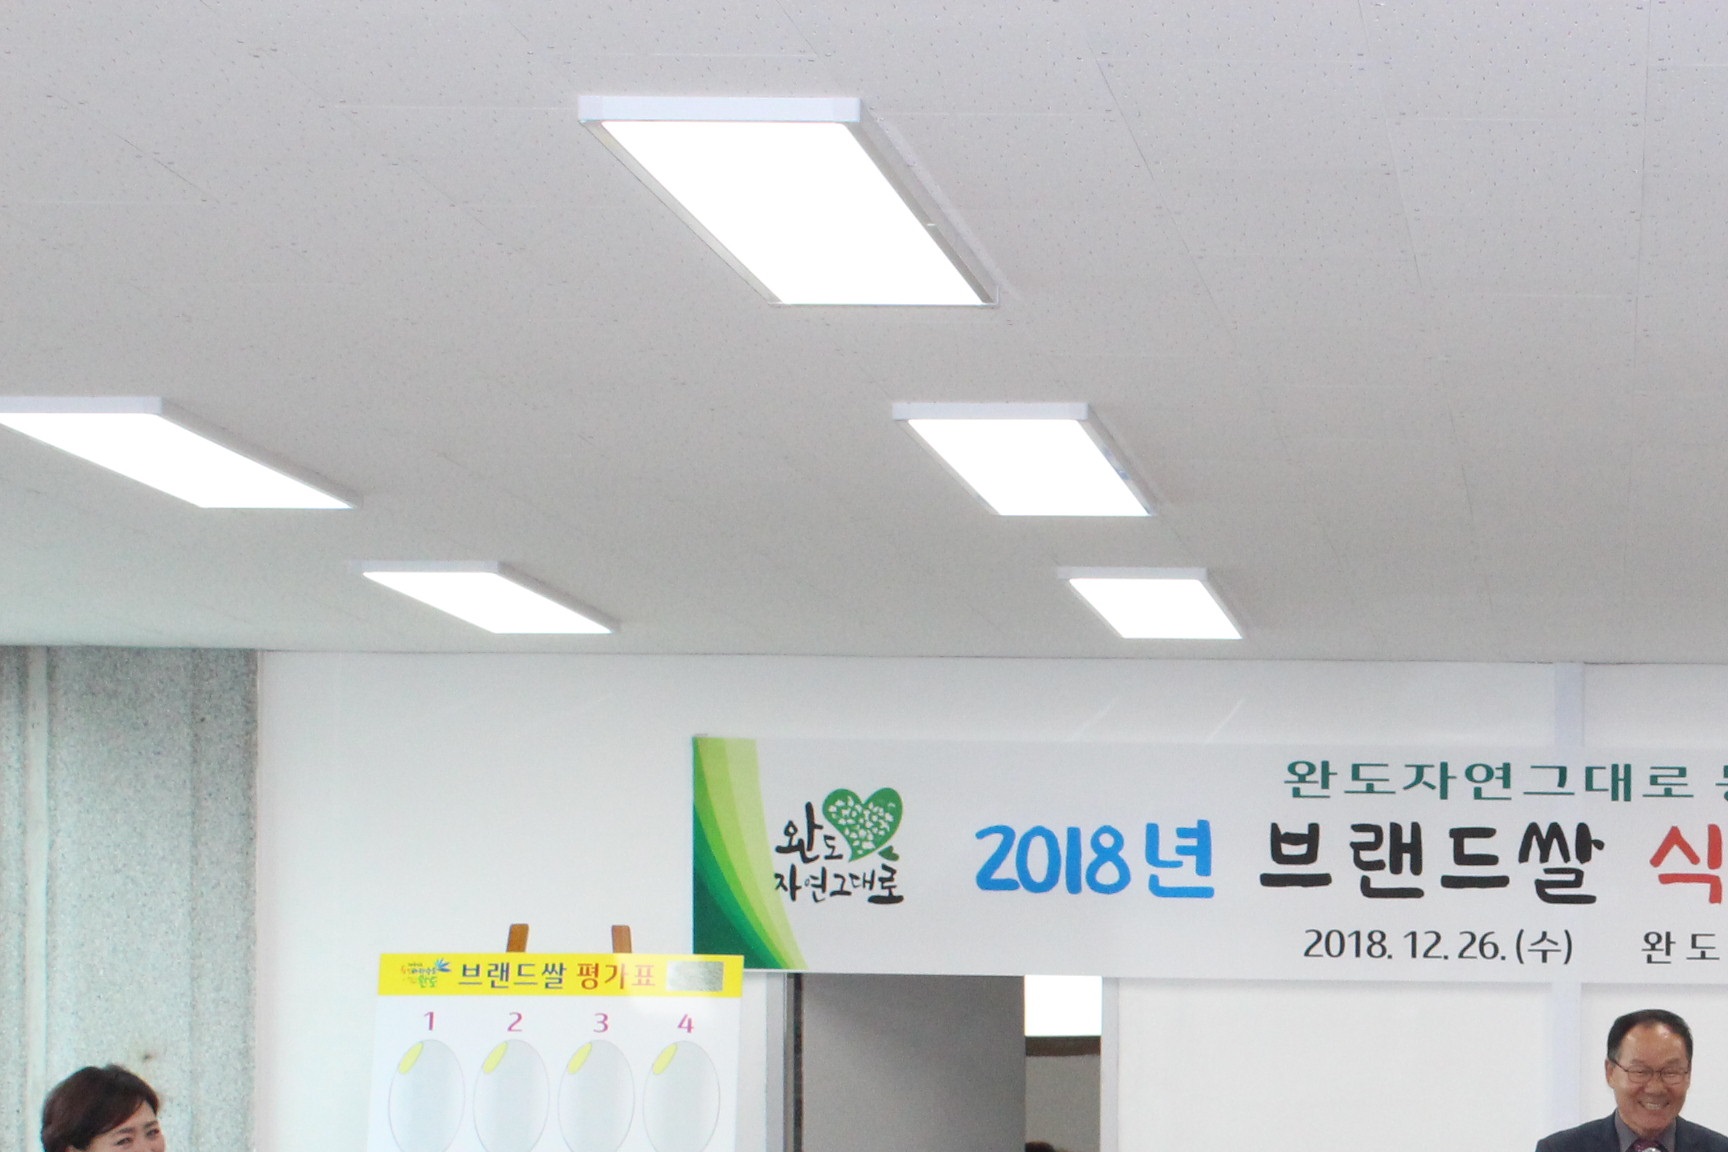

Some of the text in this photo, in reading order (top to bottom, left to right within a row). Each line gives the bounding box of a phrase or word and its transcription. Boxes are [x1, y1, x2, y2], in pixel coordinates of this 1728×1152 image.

[1283, 759, 1695, 803] 완도자연그대로
[774, 801, 844, 864] 완도
[974, 818, 1215, 899] 2018년
[1259, 820, 1606, 905] 브랜드쌀
[773, 863, 904, 905] 자연그대로
[459, 962, 567, 989] 브랜드쌀
[577, 963, 656, 990] 평가표
[423, 1011, 695, 1033] 1 2 3 4
